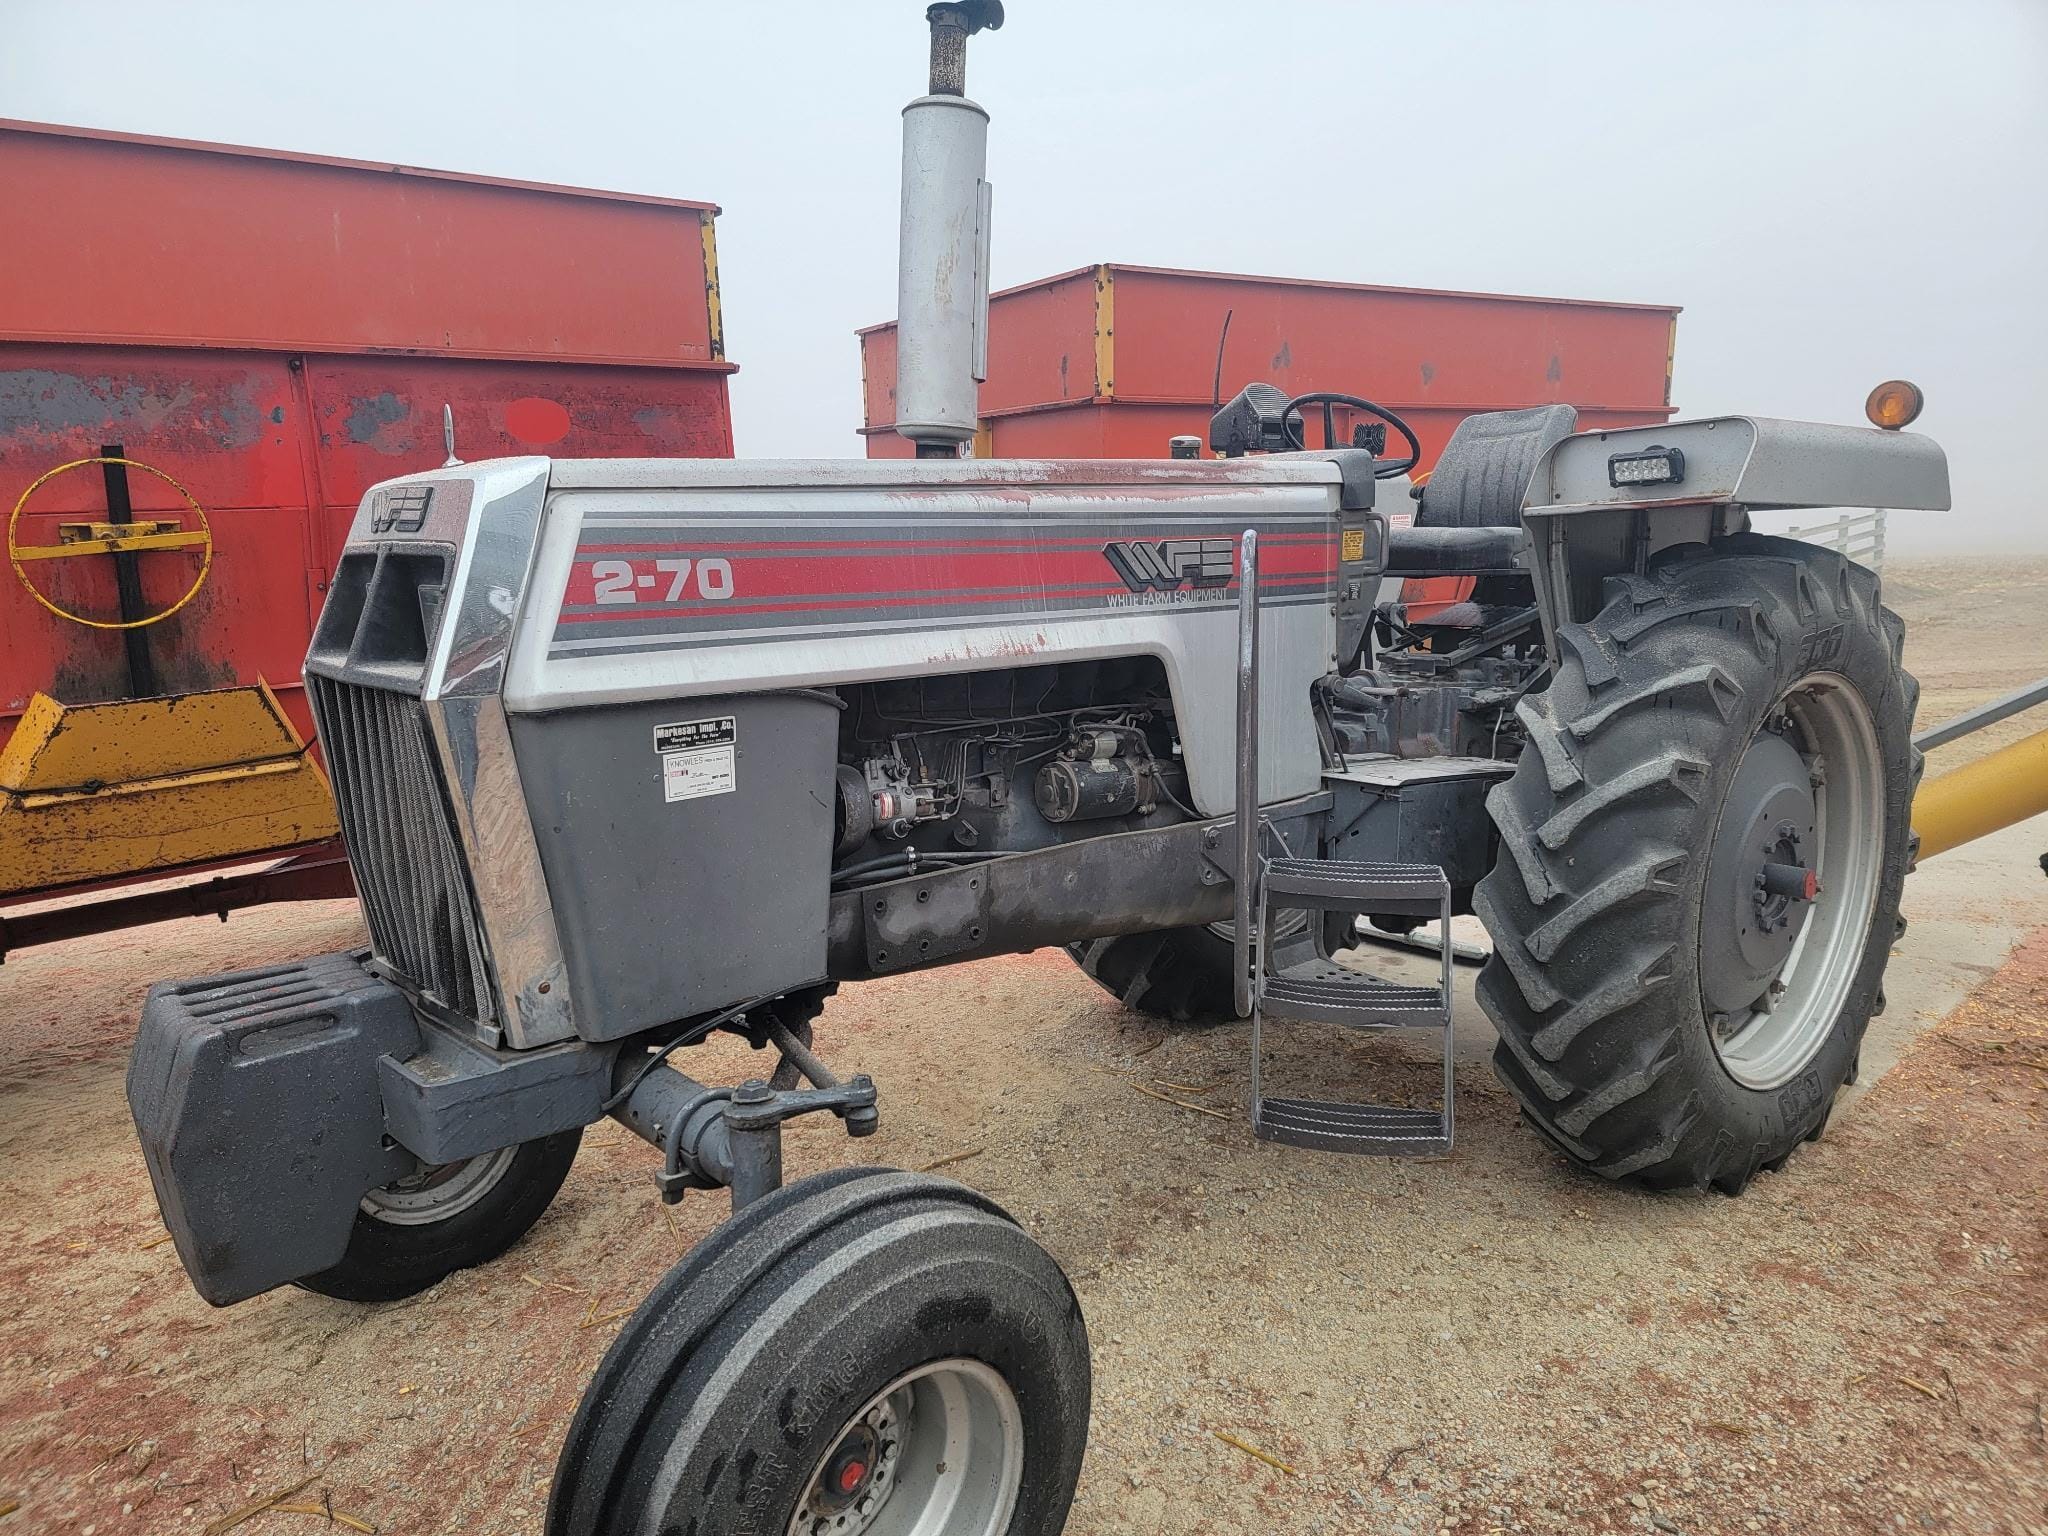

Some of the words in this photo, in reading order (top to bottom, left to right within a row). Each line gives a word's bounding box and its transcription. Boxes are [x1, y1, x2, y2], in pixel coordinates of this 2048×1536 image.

[592, 558, 735, 604] 2-70
[1107, 594, 1139, 608] WHITE
[1143, 591, 1170, 605] FARM
[1174, 588, 1228, 603] EQUIPMENT
[656, 726, 696, 739] Markesan
[699, 722, 719, 734] Impl.
[670, 756, 703, 768] KNOWLES
